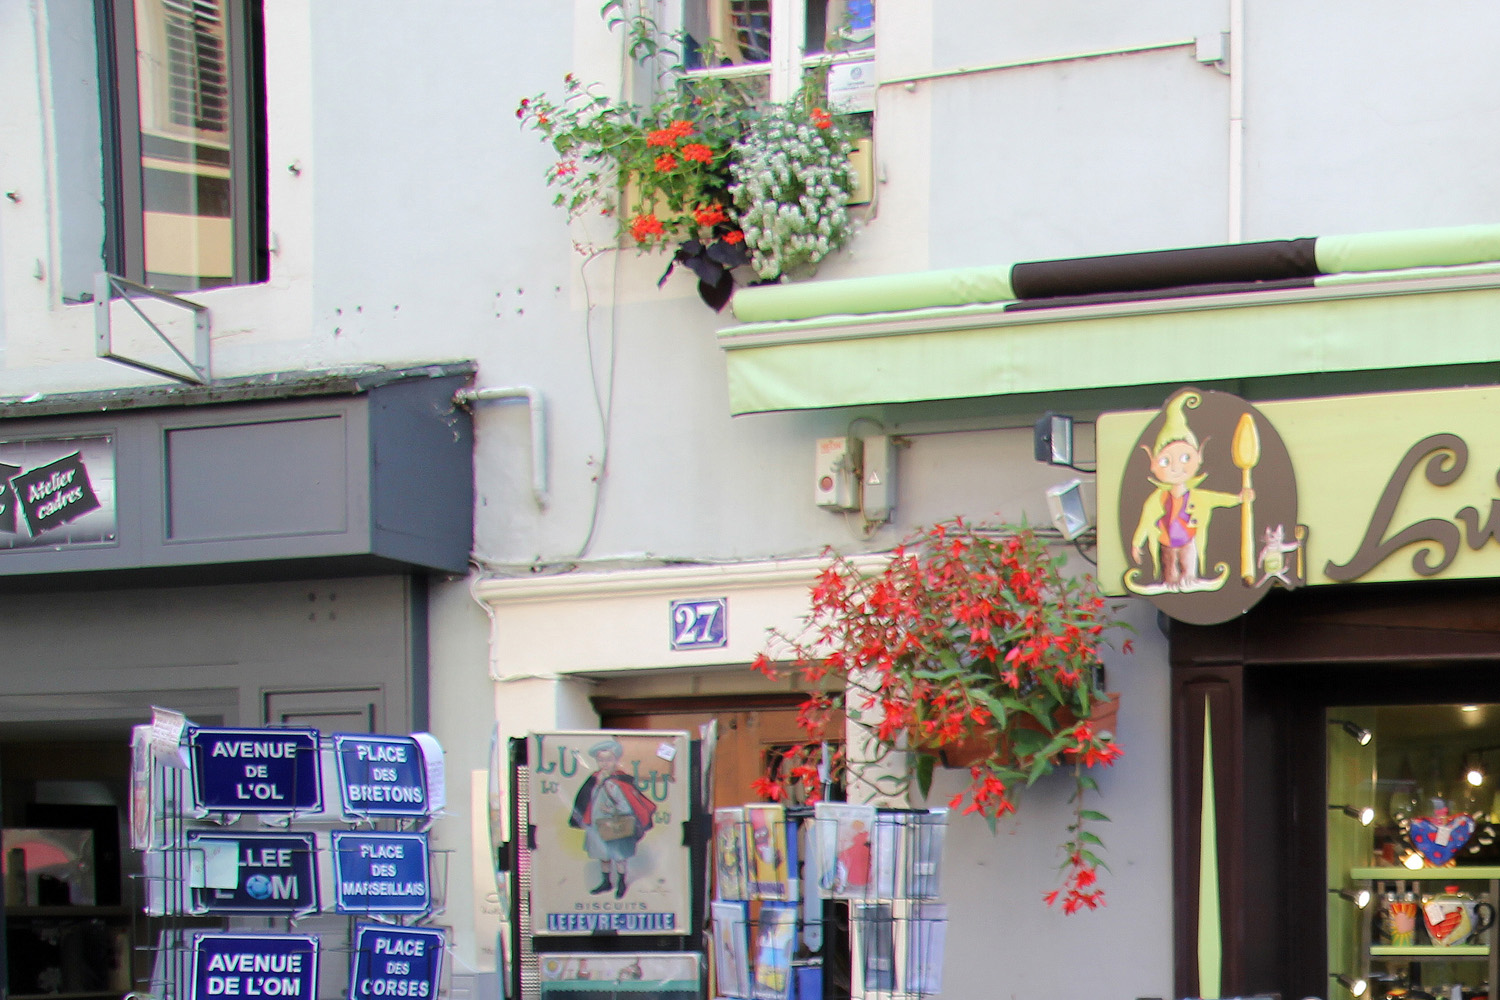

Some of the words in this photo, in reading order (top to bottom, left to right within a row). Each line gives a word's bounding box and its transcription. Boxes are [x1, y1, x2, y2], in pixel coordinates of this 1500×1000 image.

[27, 469, 76, 503] Atelier
[36, 486, 84, 520] cadres
[675, 605, 720, 644] 27
[212, 742, 297, 759] AVENUE
[357, 744, 407, 762] PLACE
[245, 765, 268, 778] DE
[373, 767, 397, 782] DES
[536, 735, 579, 777] LU
[631, 760, 669, 802] LU
[237, 784, 284, 801] L'OL
[349, 785, 423, 803] BRETONS
[239, 848, 293, 867] LEE
[361, 844, 404, 859] PLACE
[371, 864, 397, 878] DES
[343, 881, 425, 897] MARSEILLAIS
[574, 901, 648, 911] BISCUITS
[375, 938, 425, 957] PLACE
[208, 954, 301, 972] AVENUE
[386, 961, 410, 976] DES
[209, 977, 239, 995] DE
[248, 977, 300, 996] L'OM
[361, 979, 430, 997] CORSES
